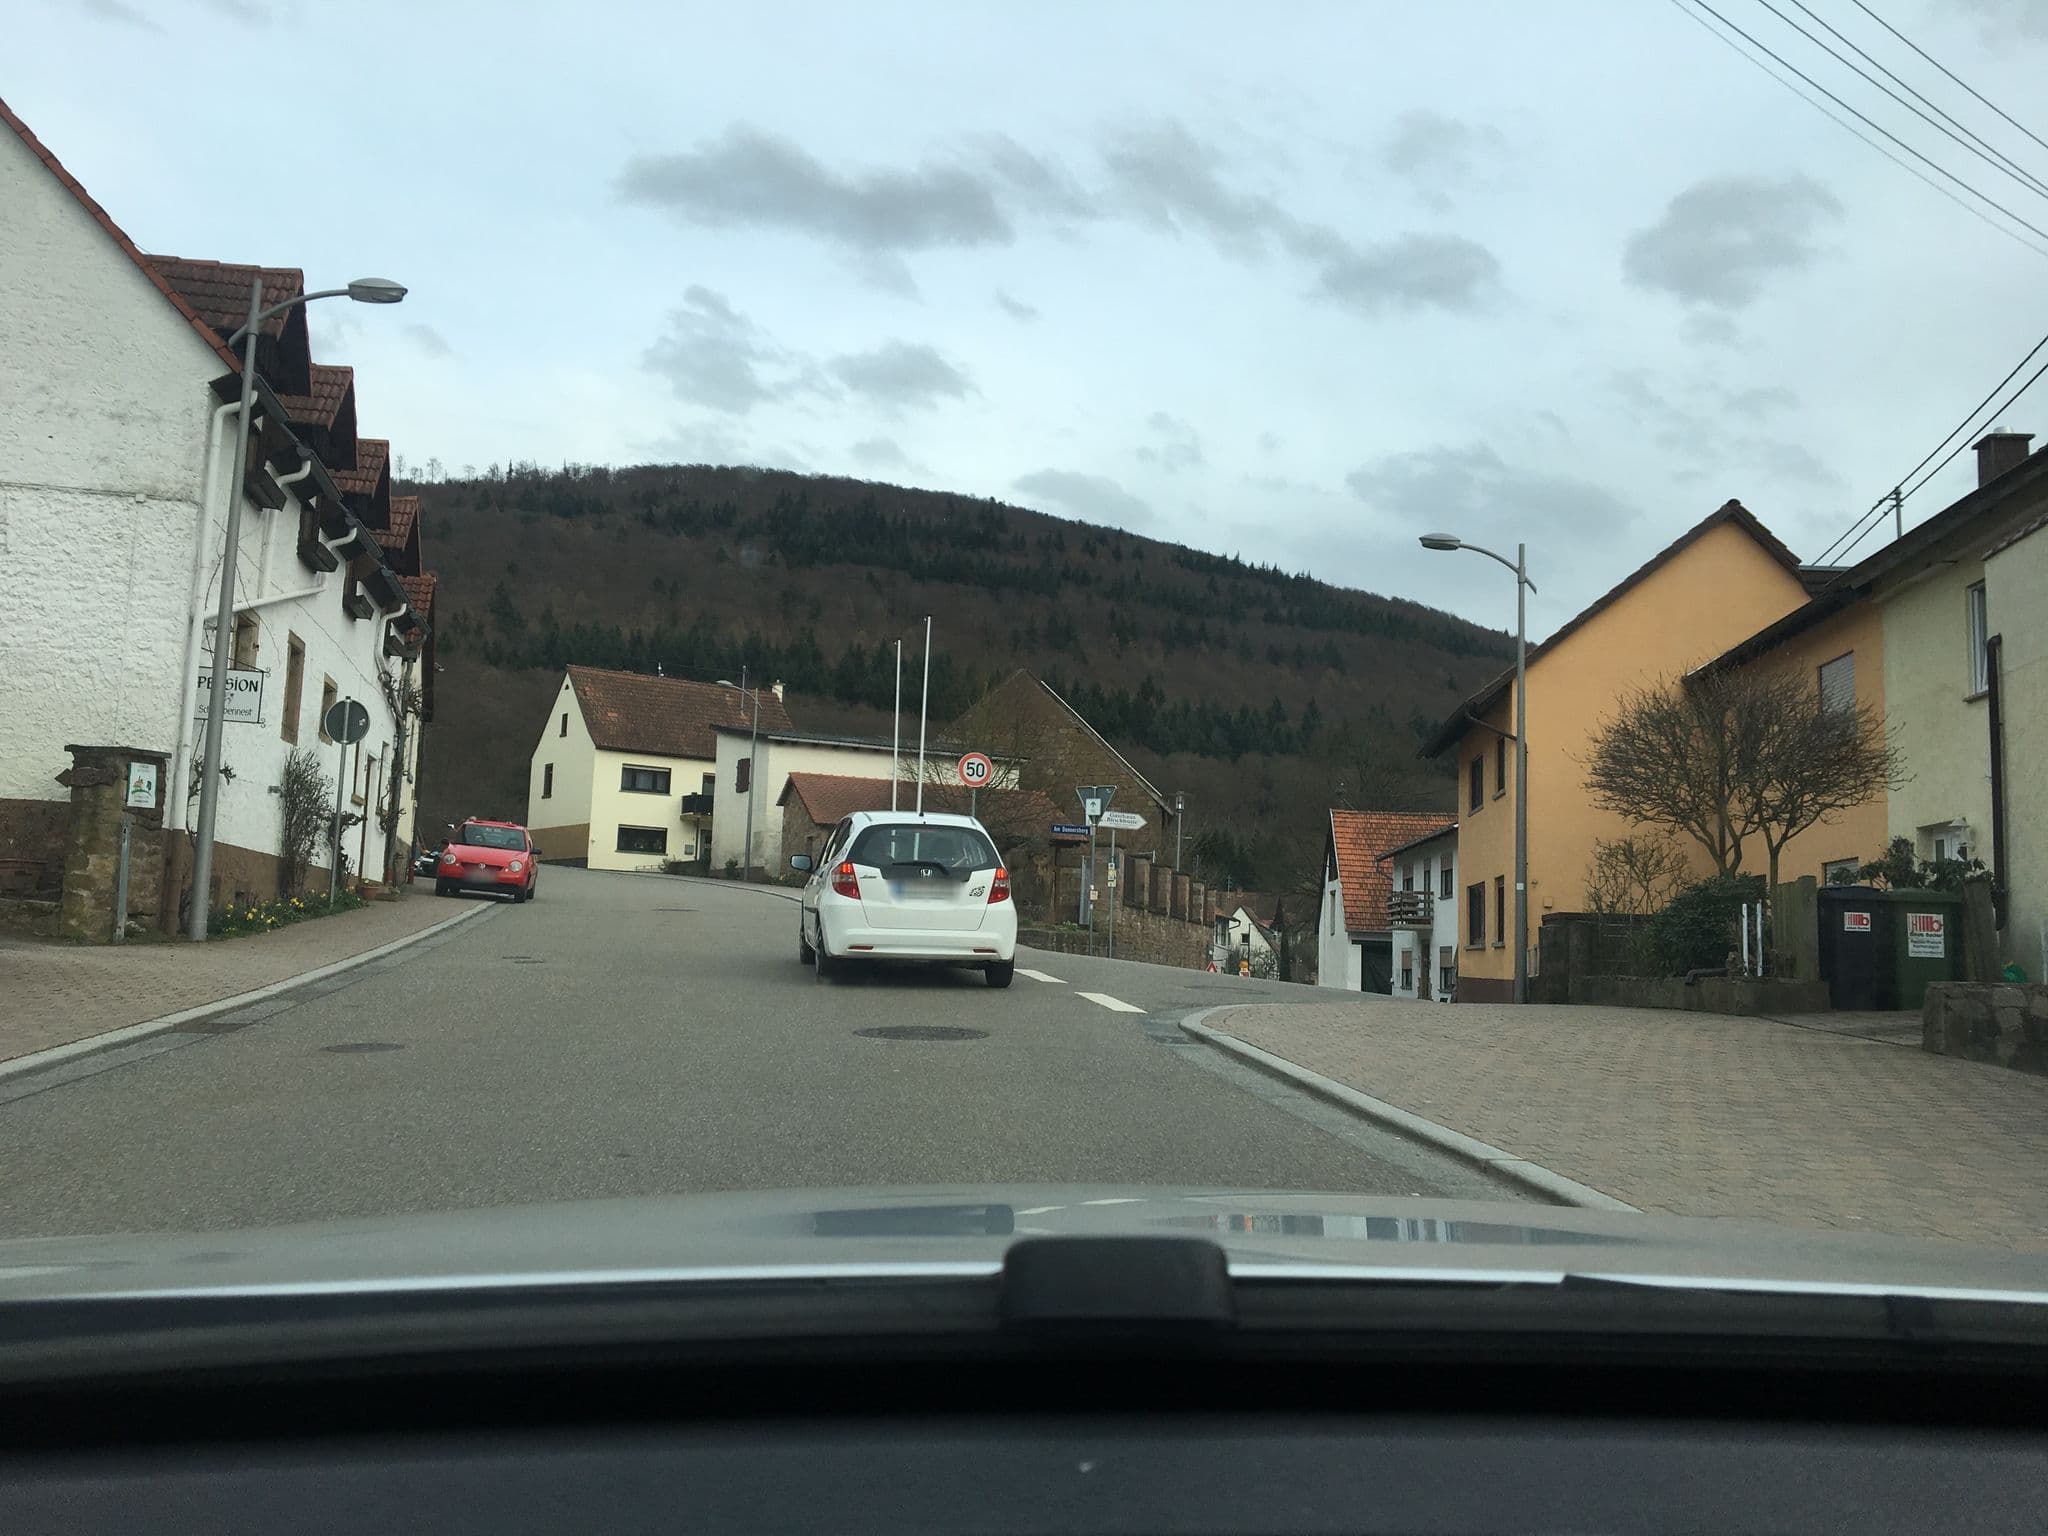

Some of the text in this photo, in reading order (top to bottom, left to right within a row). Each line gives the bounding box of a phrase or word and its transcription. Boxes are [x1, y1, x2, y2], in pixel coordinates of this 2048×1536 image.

[197, 676, 259, 692] PESION
[966, 762, 985, 777] 50
[1062, 826, 1089, 835] Donnersberg
